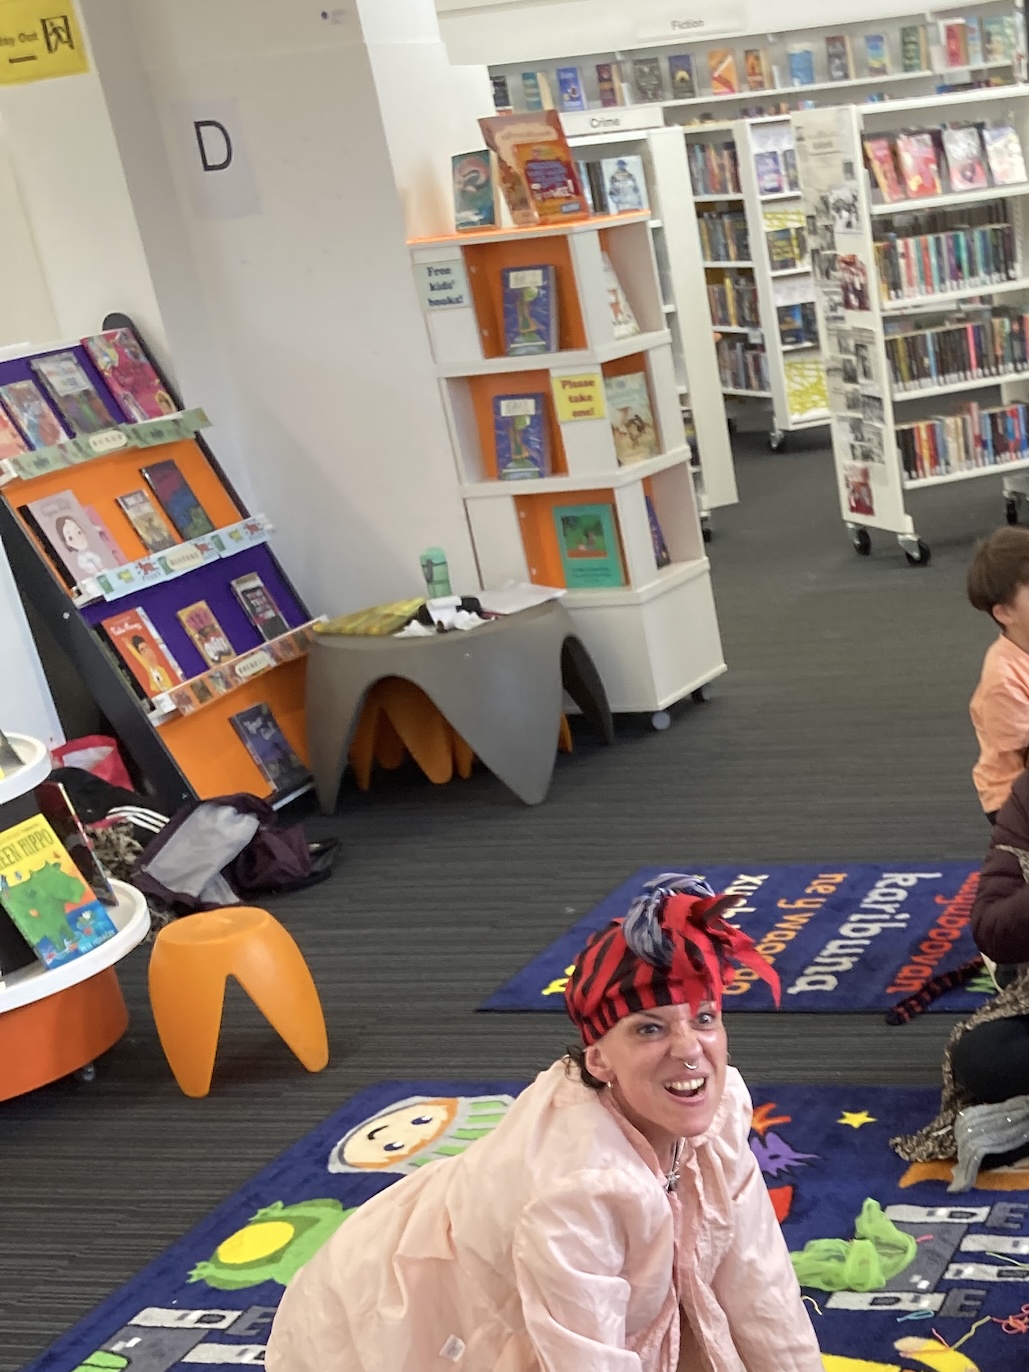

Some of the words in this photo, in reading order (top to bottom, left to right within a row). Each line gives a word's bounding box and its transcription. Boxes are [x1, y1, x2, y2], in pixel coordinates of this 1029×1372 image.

[671, 18, 704, 31] Fiction
[590, 117, 621, 128] Crime
[194, 120, 232, 171] D
[426, 266, 452, 277] Free
[428, 295, 463, 306] books!
[562, 380, 595, 389] Please
[568, 394, 593, 403] take
[572, 407, 595, 417] one!
[17, 828, 54, 857] HIPPO
[787, 872, 942, 994] karibuna
